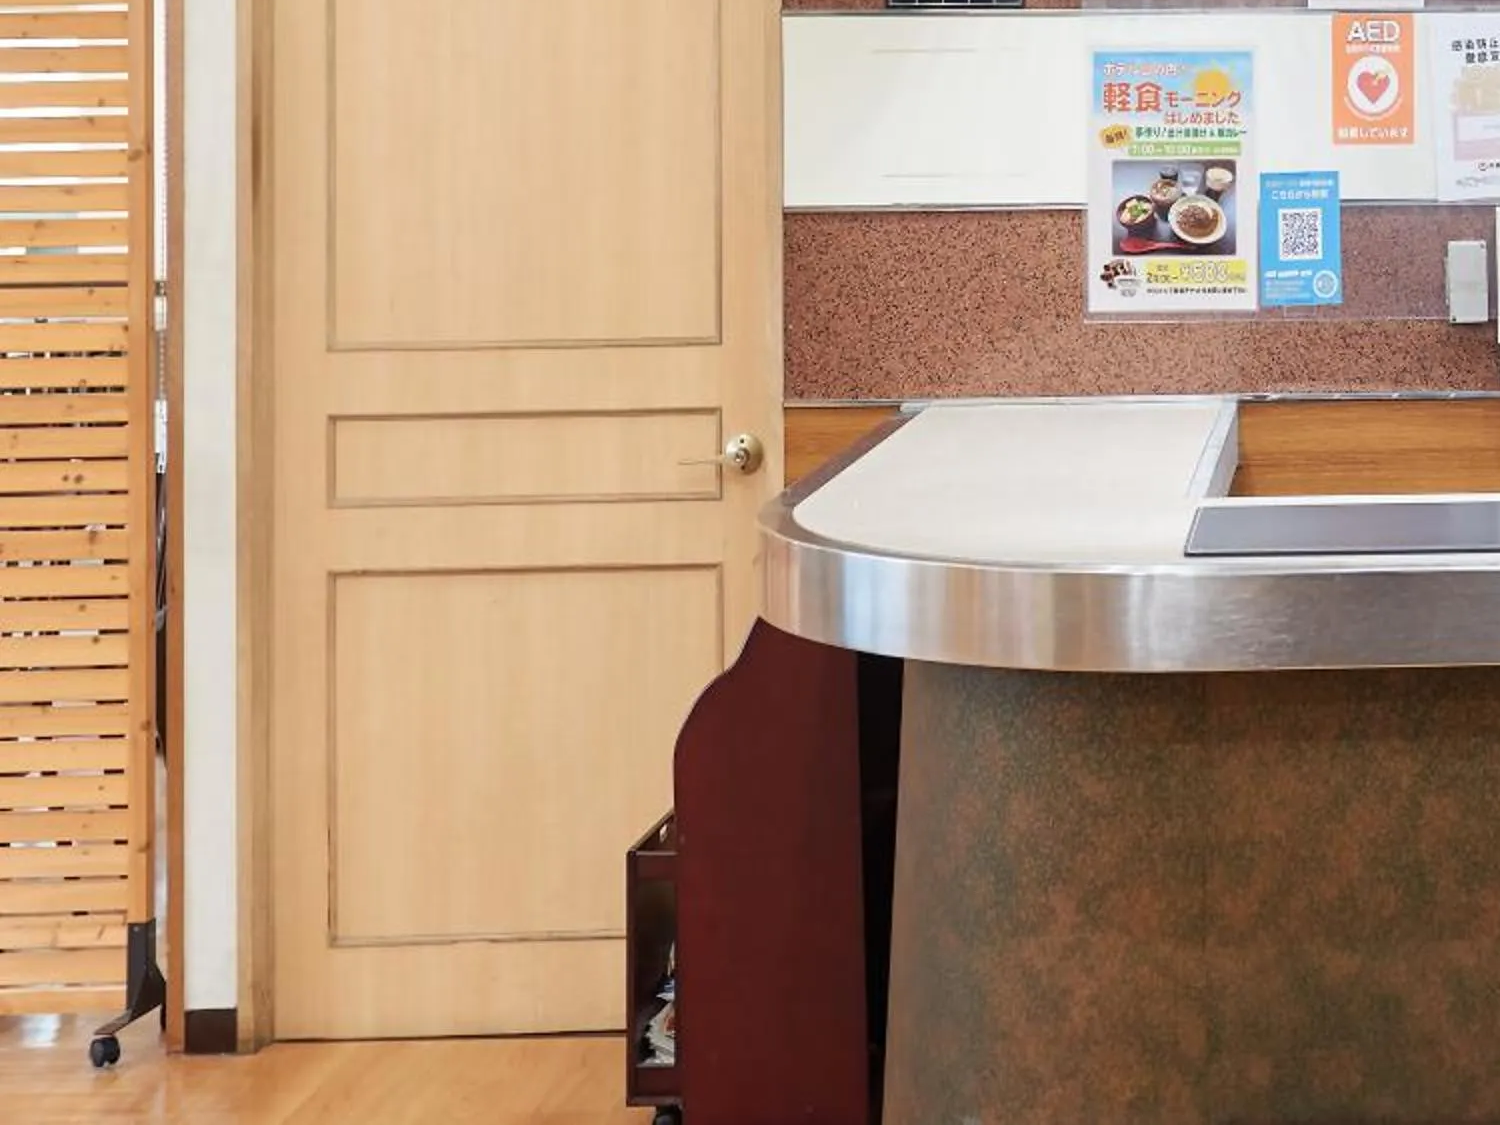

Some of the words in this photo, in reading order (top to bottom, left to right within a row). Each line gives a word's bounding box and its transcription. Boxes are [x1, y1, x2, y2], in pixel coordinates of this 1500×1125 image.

[1346, 20, 1401, 42] AED
[1103, 81, 1243, 113] 軽食モーニング
